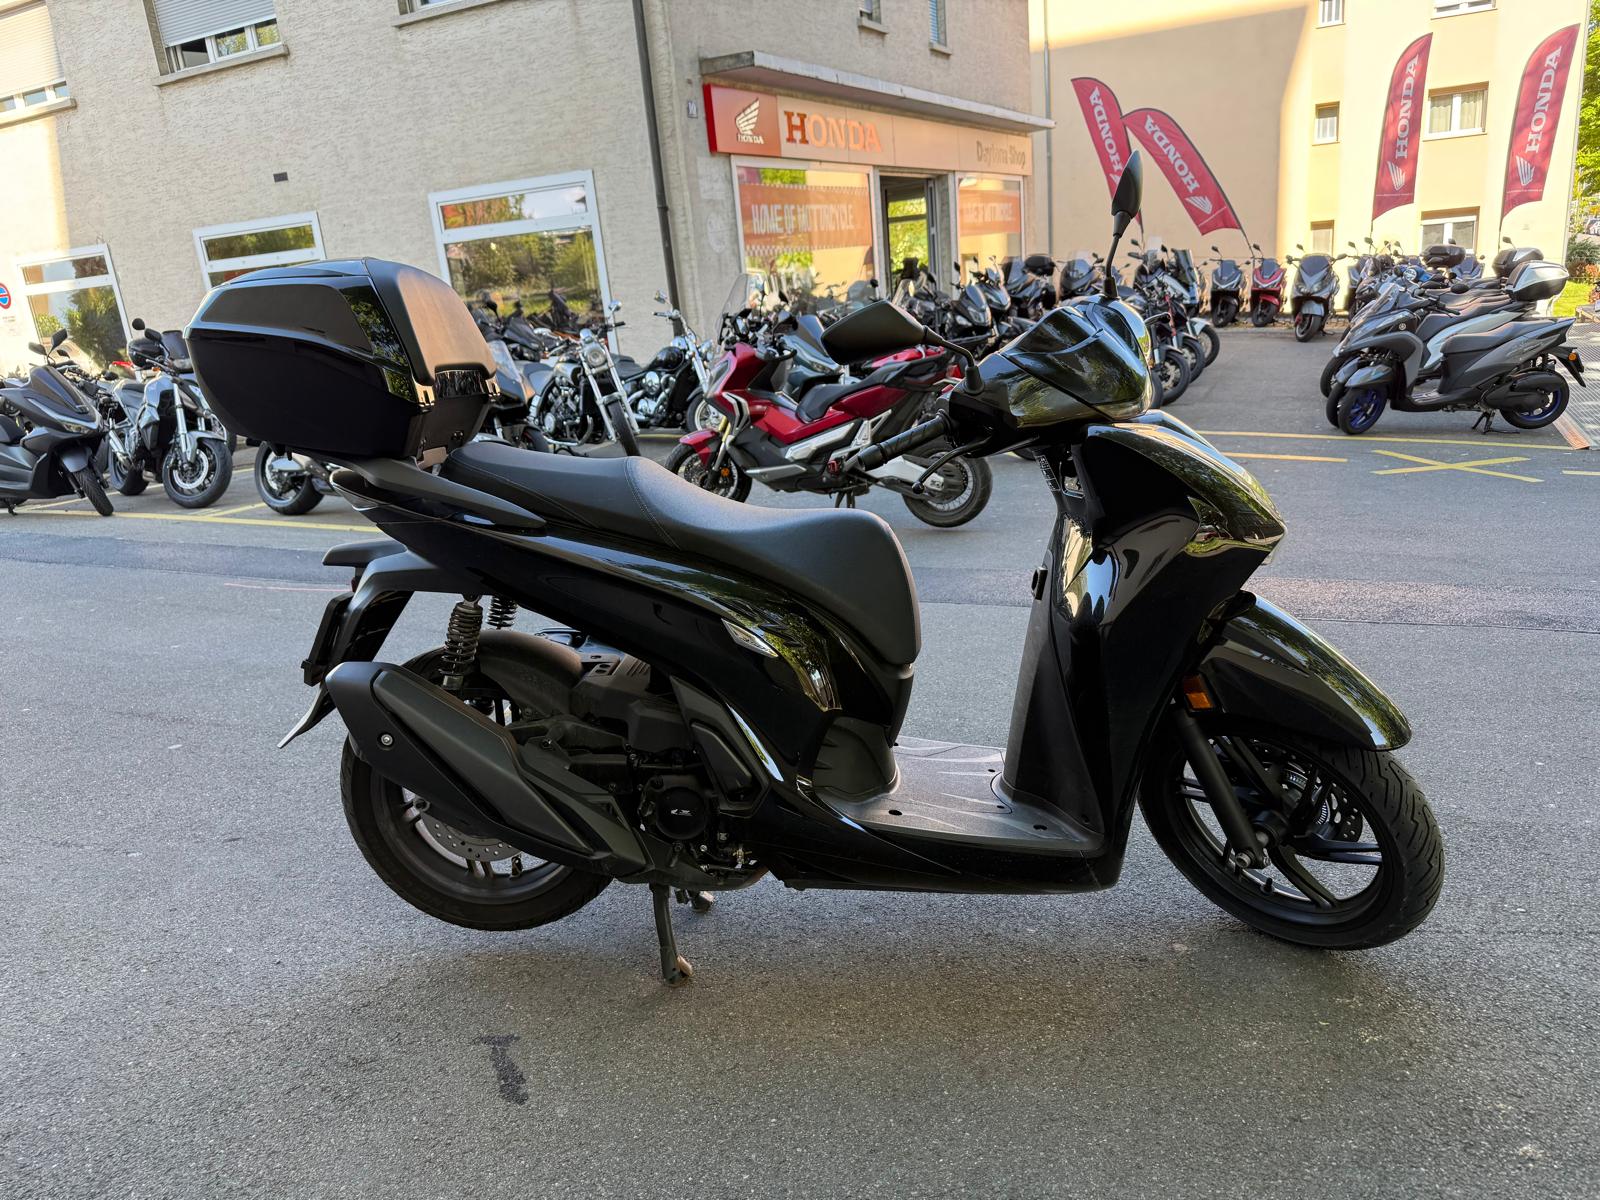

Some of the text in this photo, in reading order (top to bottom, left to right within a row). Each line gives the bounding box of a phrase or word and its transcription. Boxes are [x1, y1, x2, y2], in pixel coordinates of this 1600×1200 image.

[737, 133, 764, 144] HONDA
[784, 111, 881, 152] HONDA
[1089, 86, 1123, 172] HONDA
[1395, 54, 1419, 159] HONDA
[1525, 46, 1562, 153] HONDA
[1144, 114, 1200, 193] HONDA
[751, 203, 784, 235] HOME
[784, 203, 796, 235] OF
